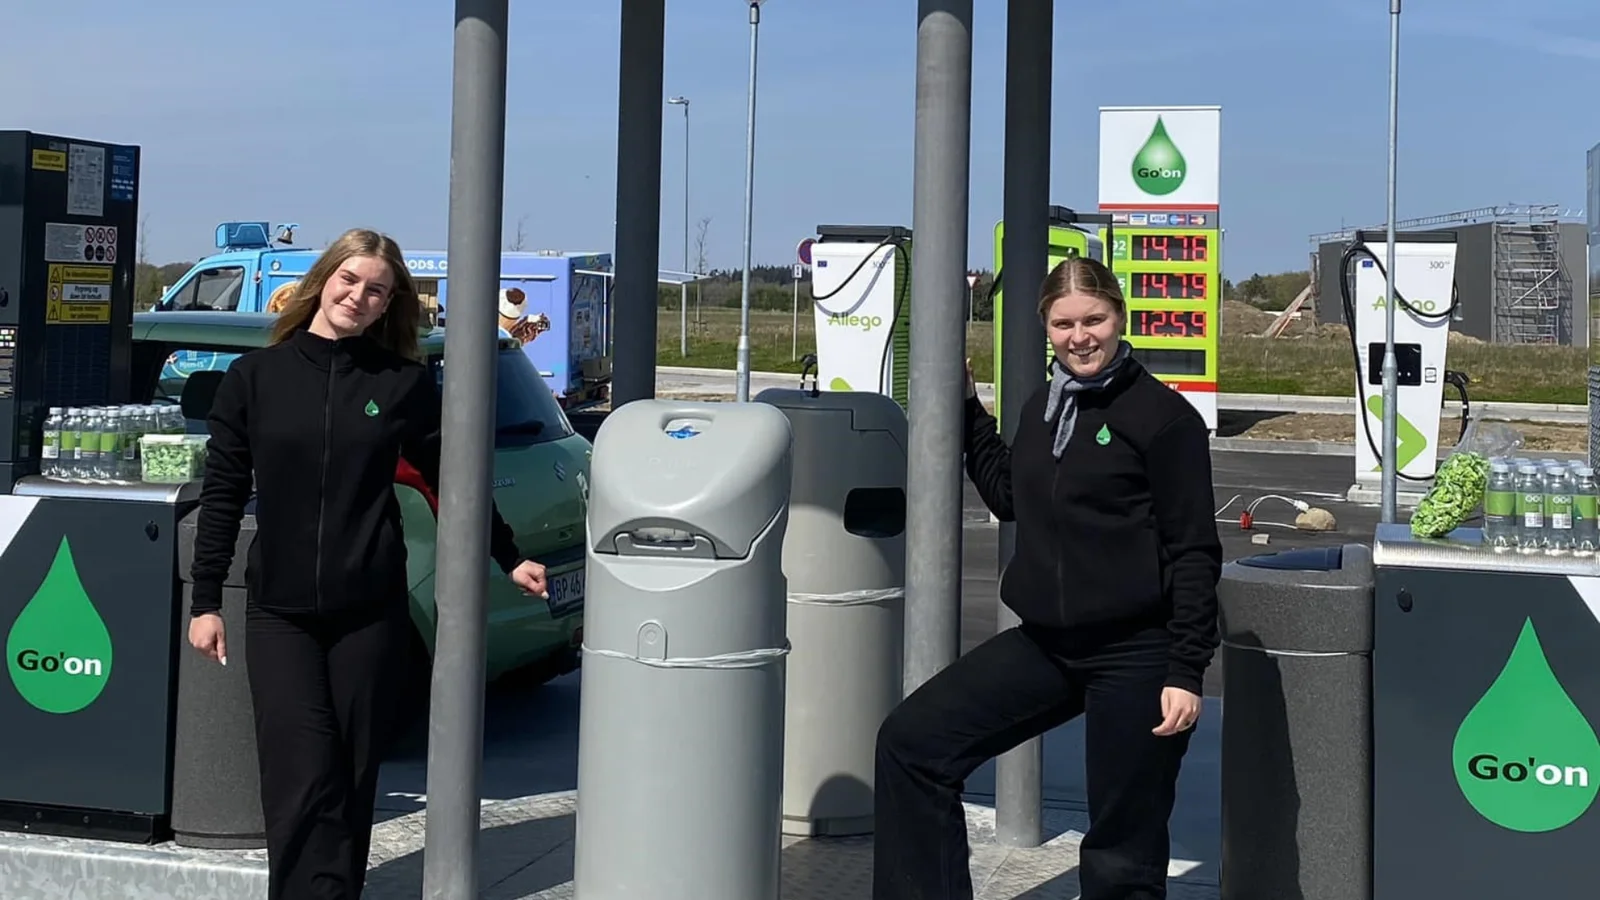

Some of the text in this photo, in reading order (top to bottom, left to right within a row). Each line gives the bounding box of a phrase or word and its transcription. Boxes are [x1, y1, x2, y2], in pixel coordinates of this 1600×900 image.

[1137, 167, 1181, 178] Go'on
[828, 312, 882, 331] Allego
[16, 648, 102, 676] Go'on
[1467, 753, 1590, 788] Go'on
